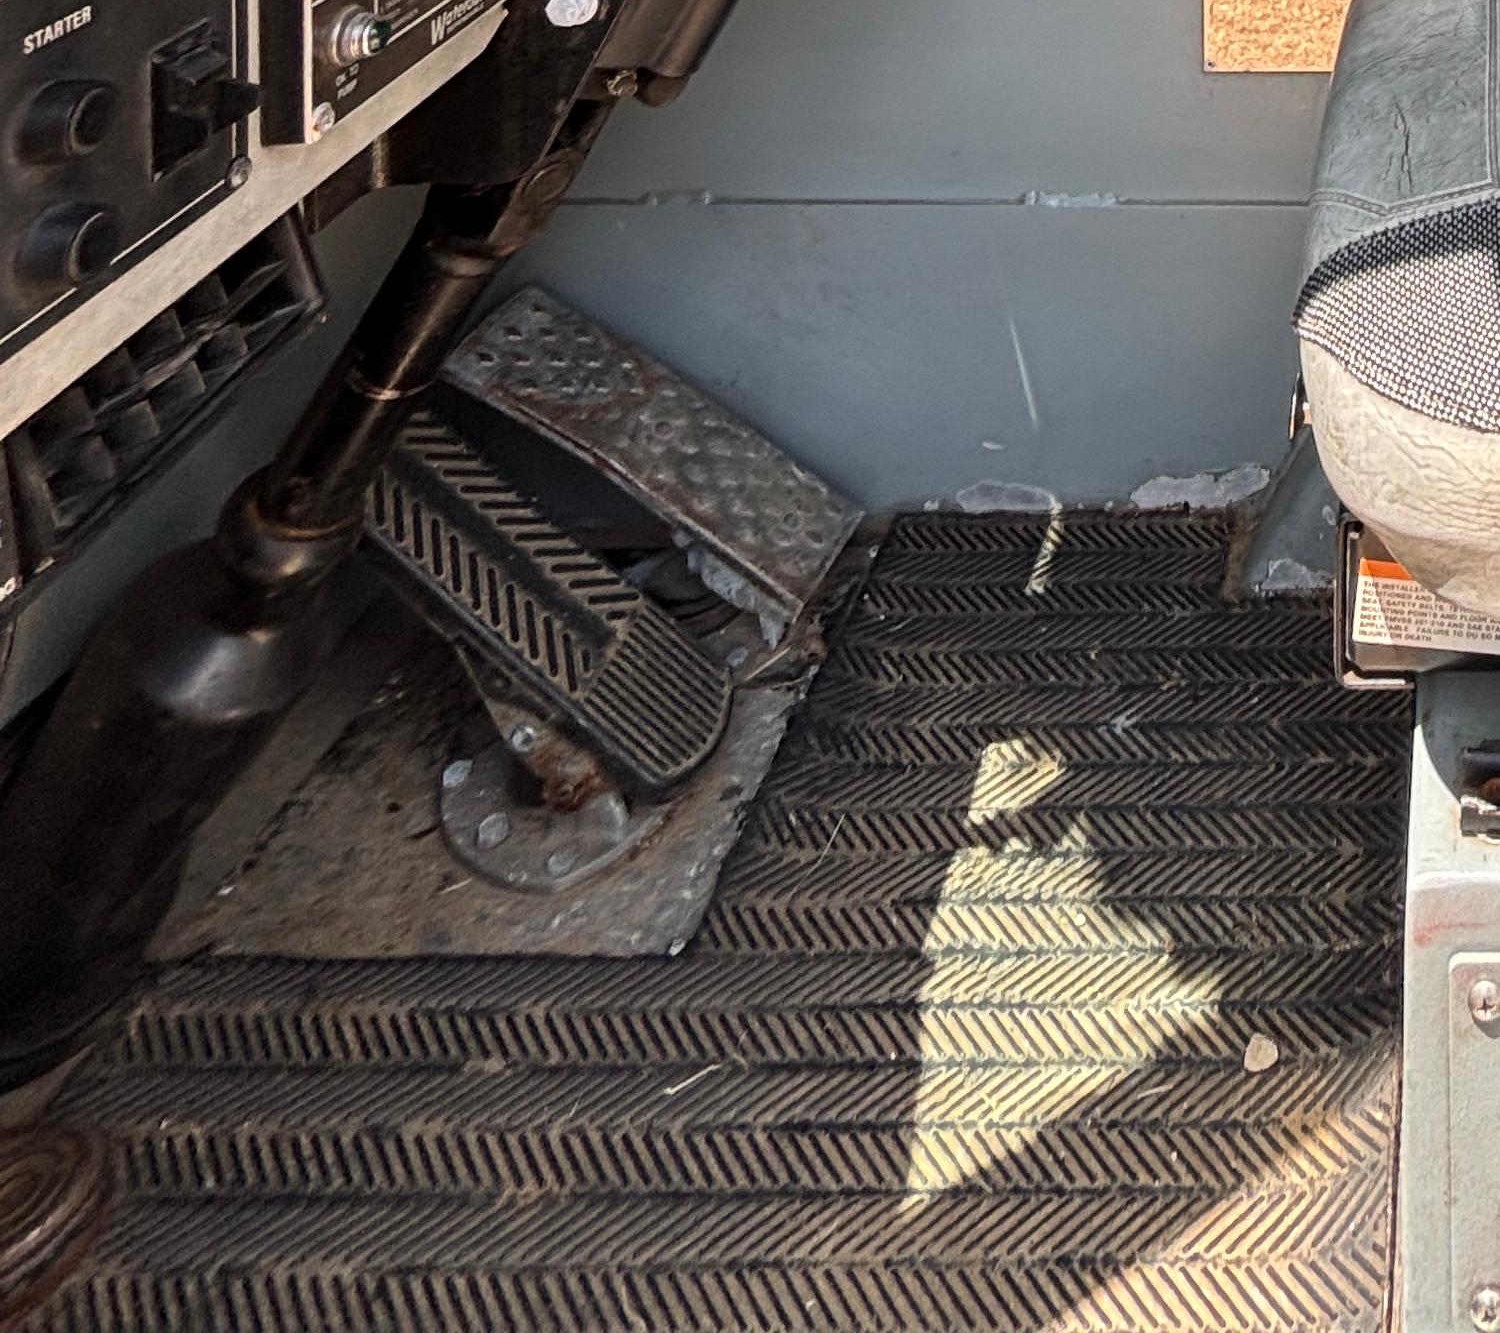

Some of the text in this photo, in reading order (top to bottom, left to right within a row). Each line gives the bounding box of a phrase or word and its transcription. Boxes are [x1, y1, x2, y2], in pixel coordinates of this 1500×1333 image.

[23, 5, 92, 55] STARTER
[1386, 599, 1417, 608] SAFETY
[1404, 633, 1432, 642] DEATH
